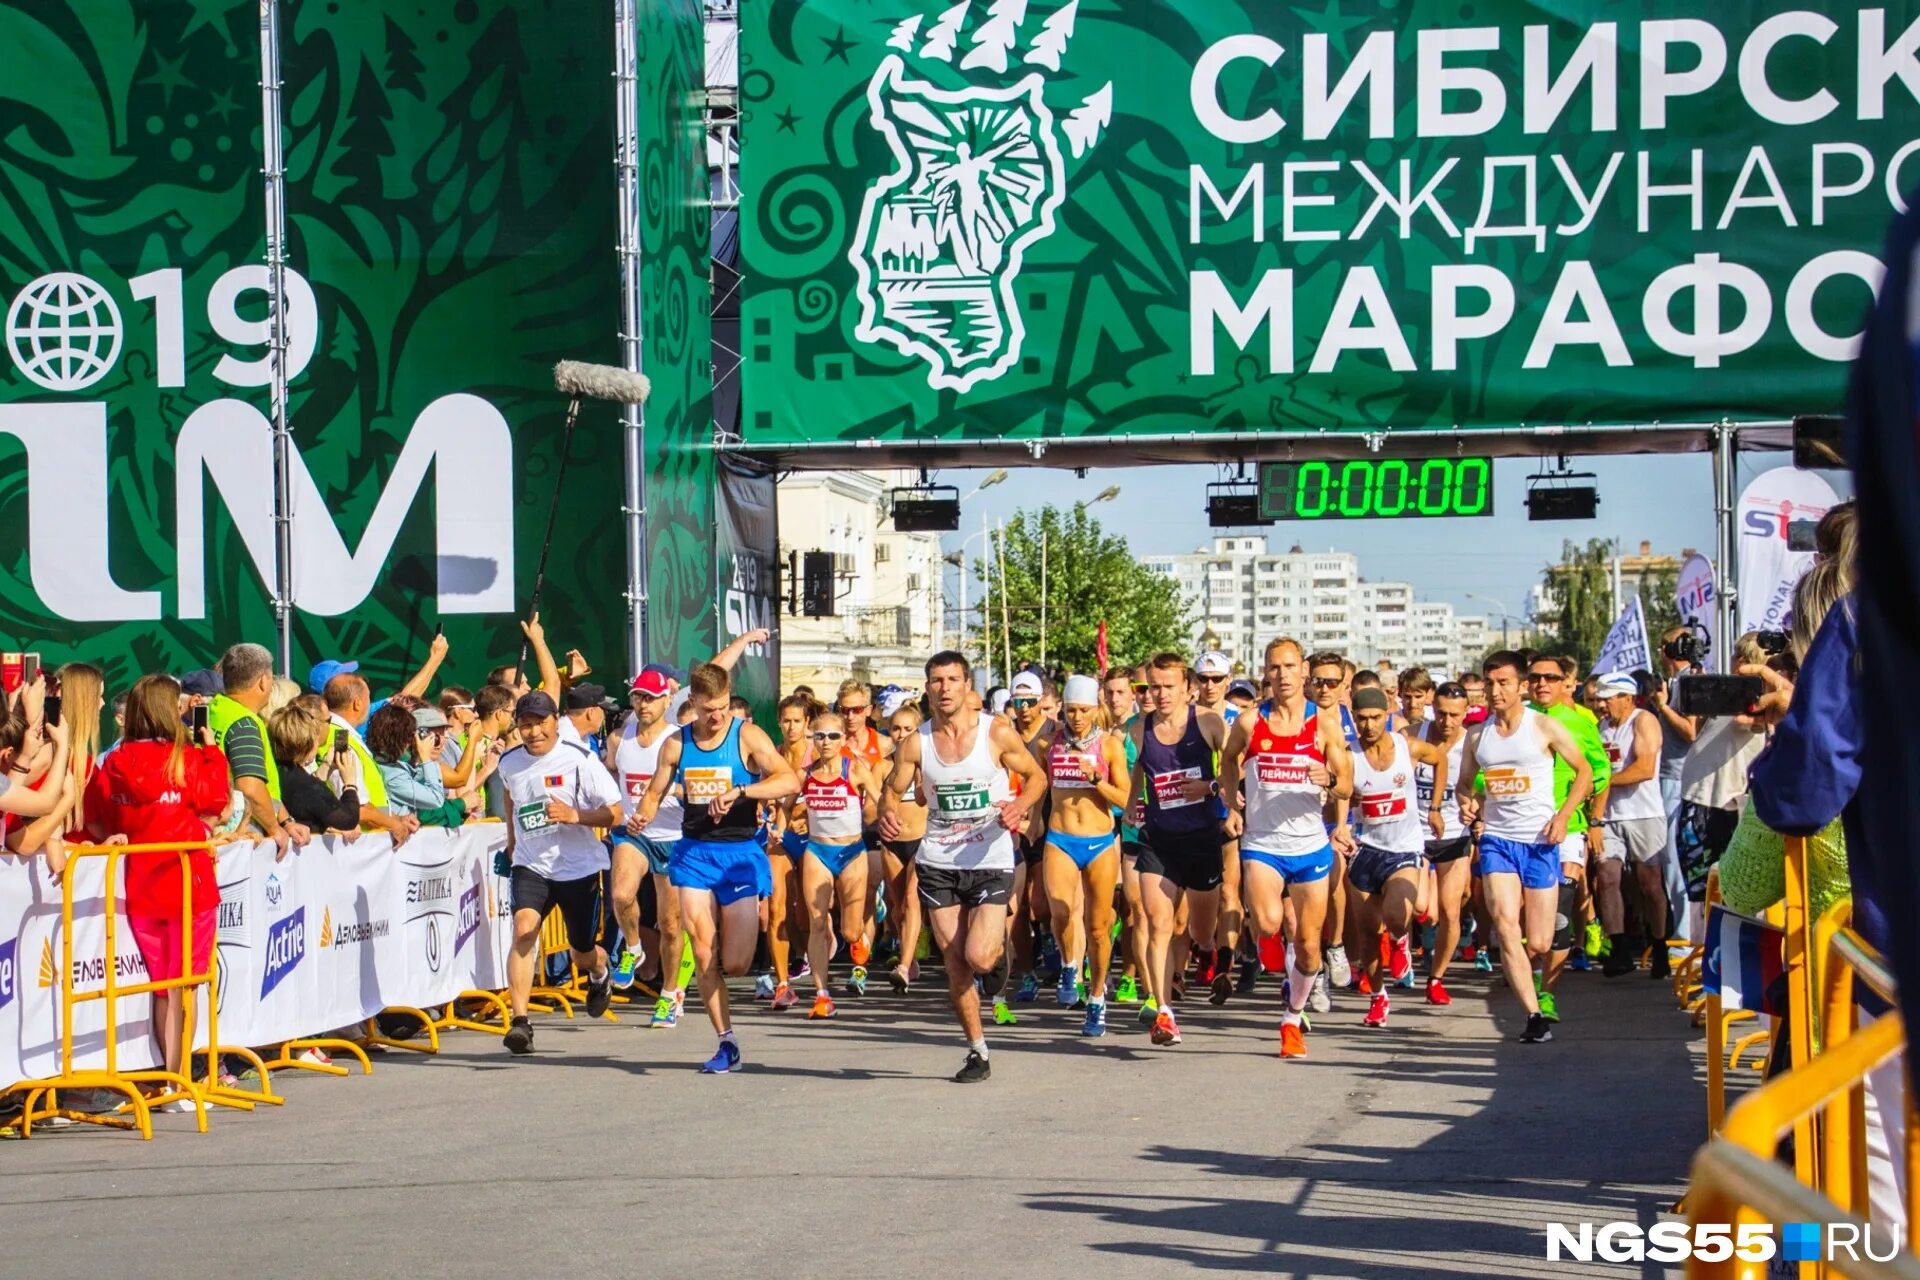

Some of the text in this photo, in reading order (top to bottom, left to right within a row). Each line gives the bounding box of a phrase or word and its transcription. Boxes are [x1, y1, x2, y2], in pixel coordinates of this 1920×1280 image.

[1190, 9, 1920, 144] СИБИРСК
[1296, 459, 1488, 517] 0:00:00
[1260, 767, 1306, 780] ЛЕЙМАН
[690, 780, 728, 795] 2005
[1488, 779, 1524, 793] 2540
[945, 793, 982, 810] 1371
[1376, 801, 1393, 816] 17
[266, 919, 304, 978] Active
